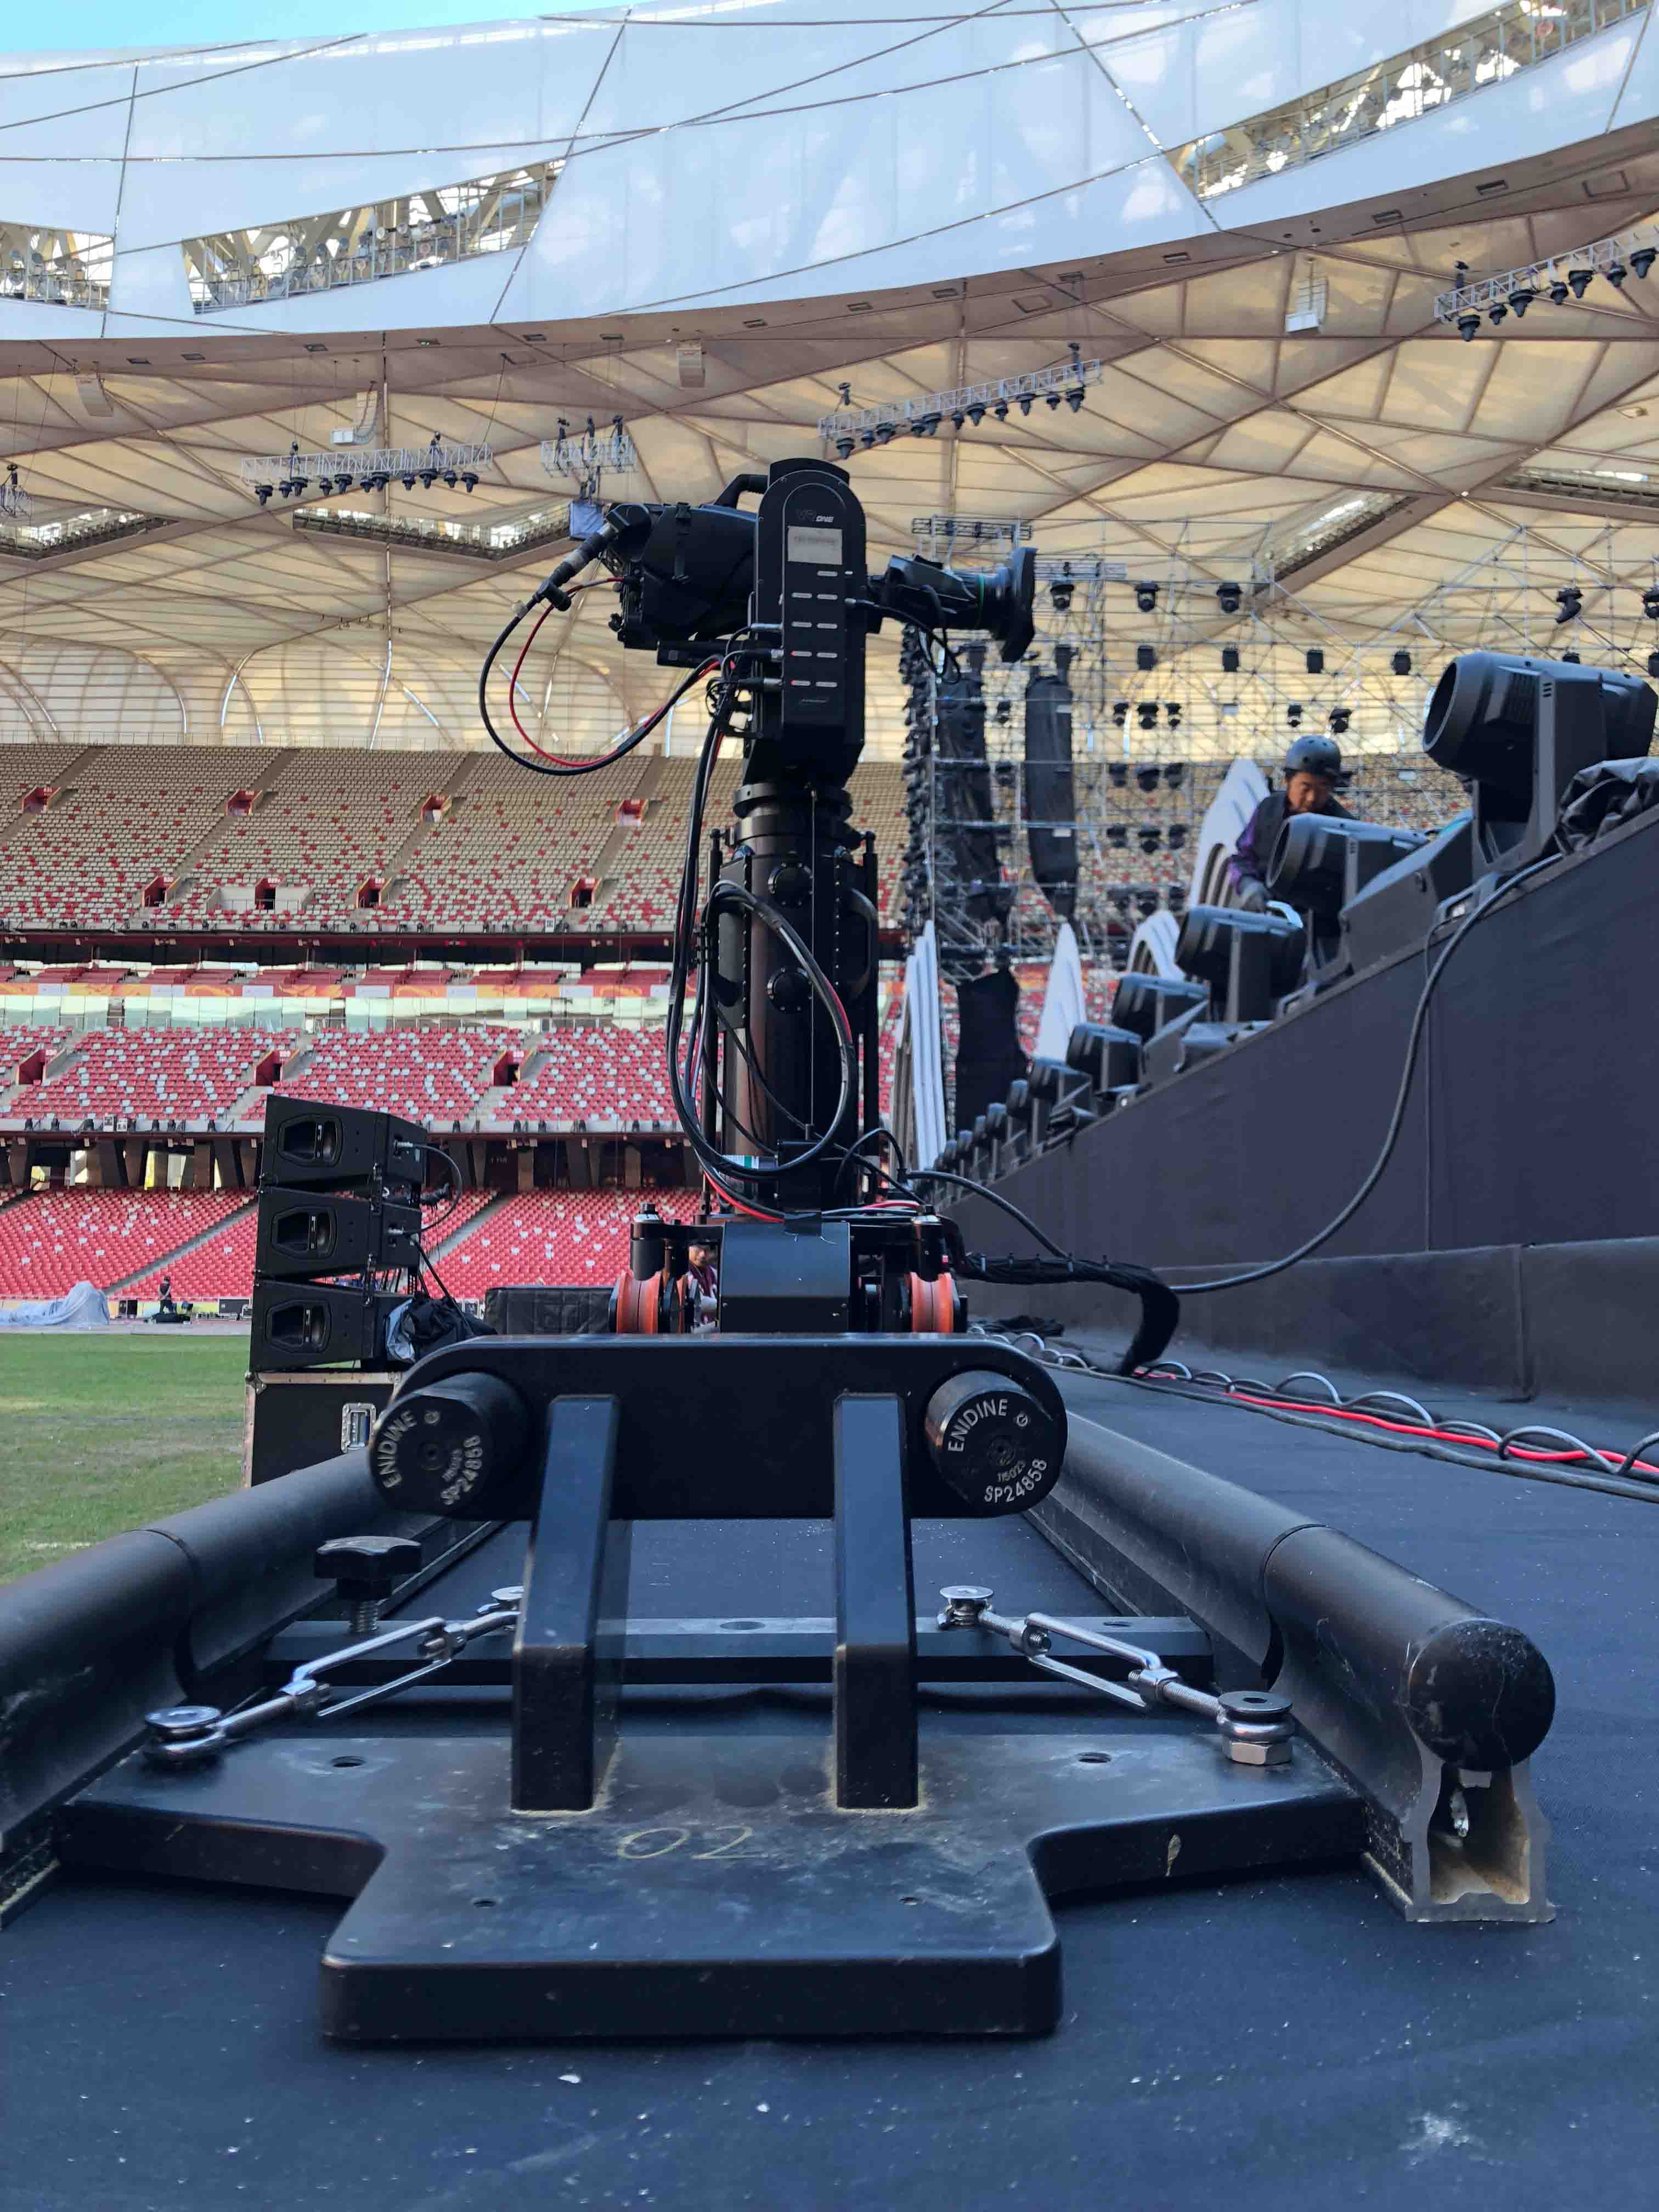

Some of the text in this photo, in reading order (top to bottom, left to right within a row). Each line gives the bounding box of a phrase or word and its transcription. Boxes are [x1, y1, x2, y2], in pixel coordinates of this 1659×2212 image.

[377, 1410, 416, 1488] ENIDINE
[948, 1398, 1008, 1452] ENIDINE
[984, 1459, 1047, 1503] SP24858
[617, 1825, 770, 1860] 02
